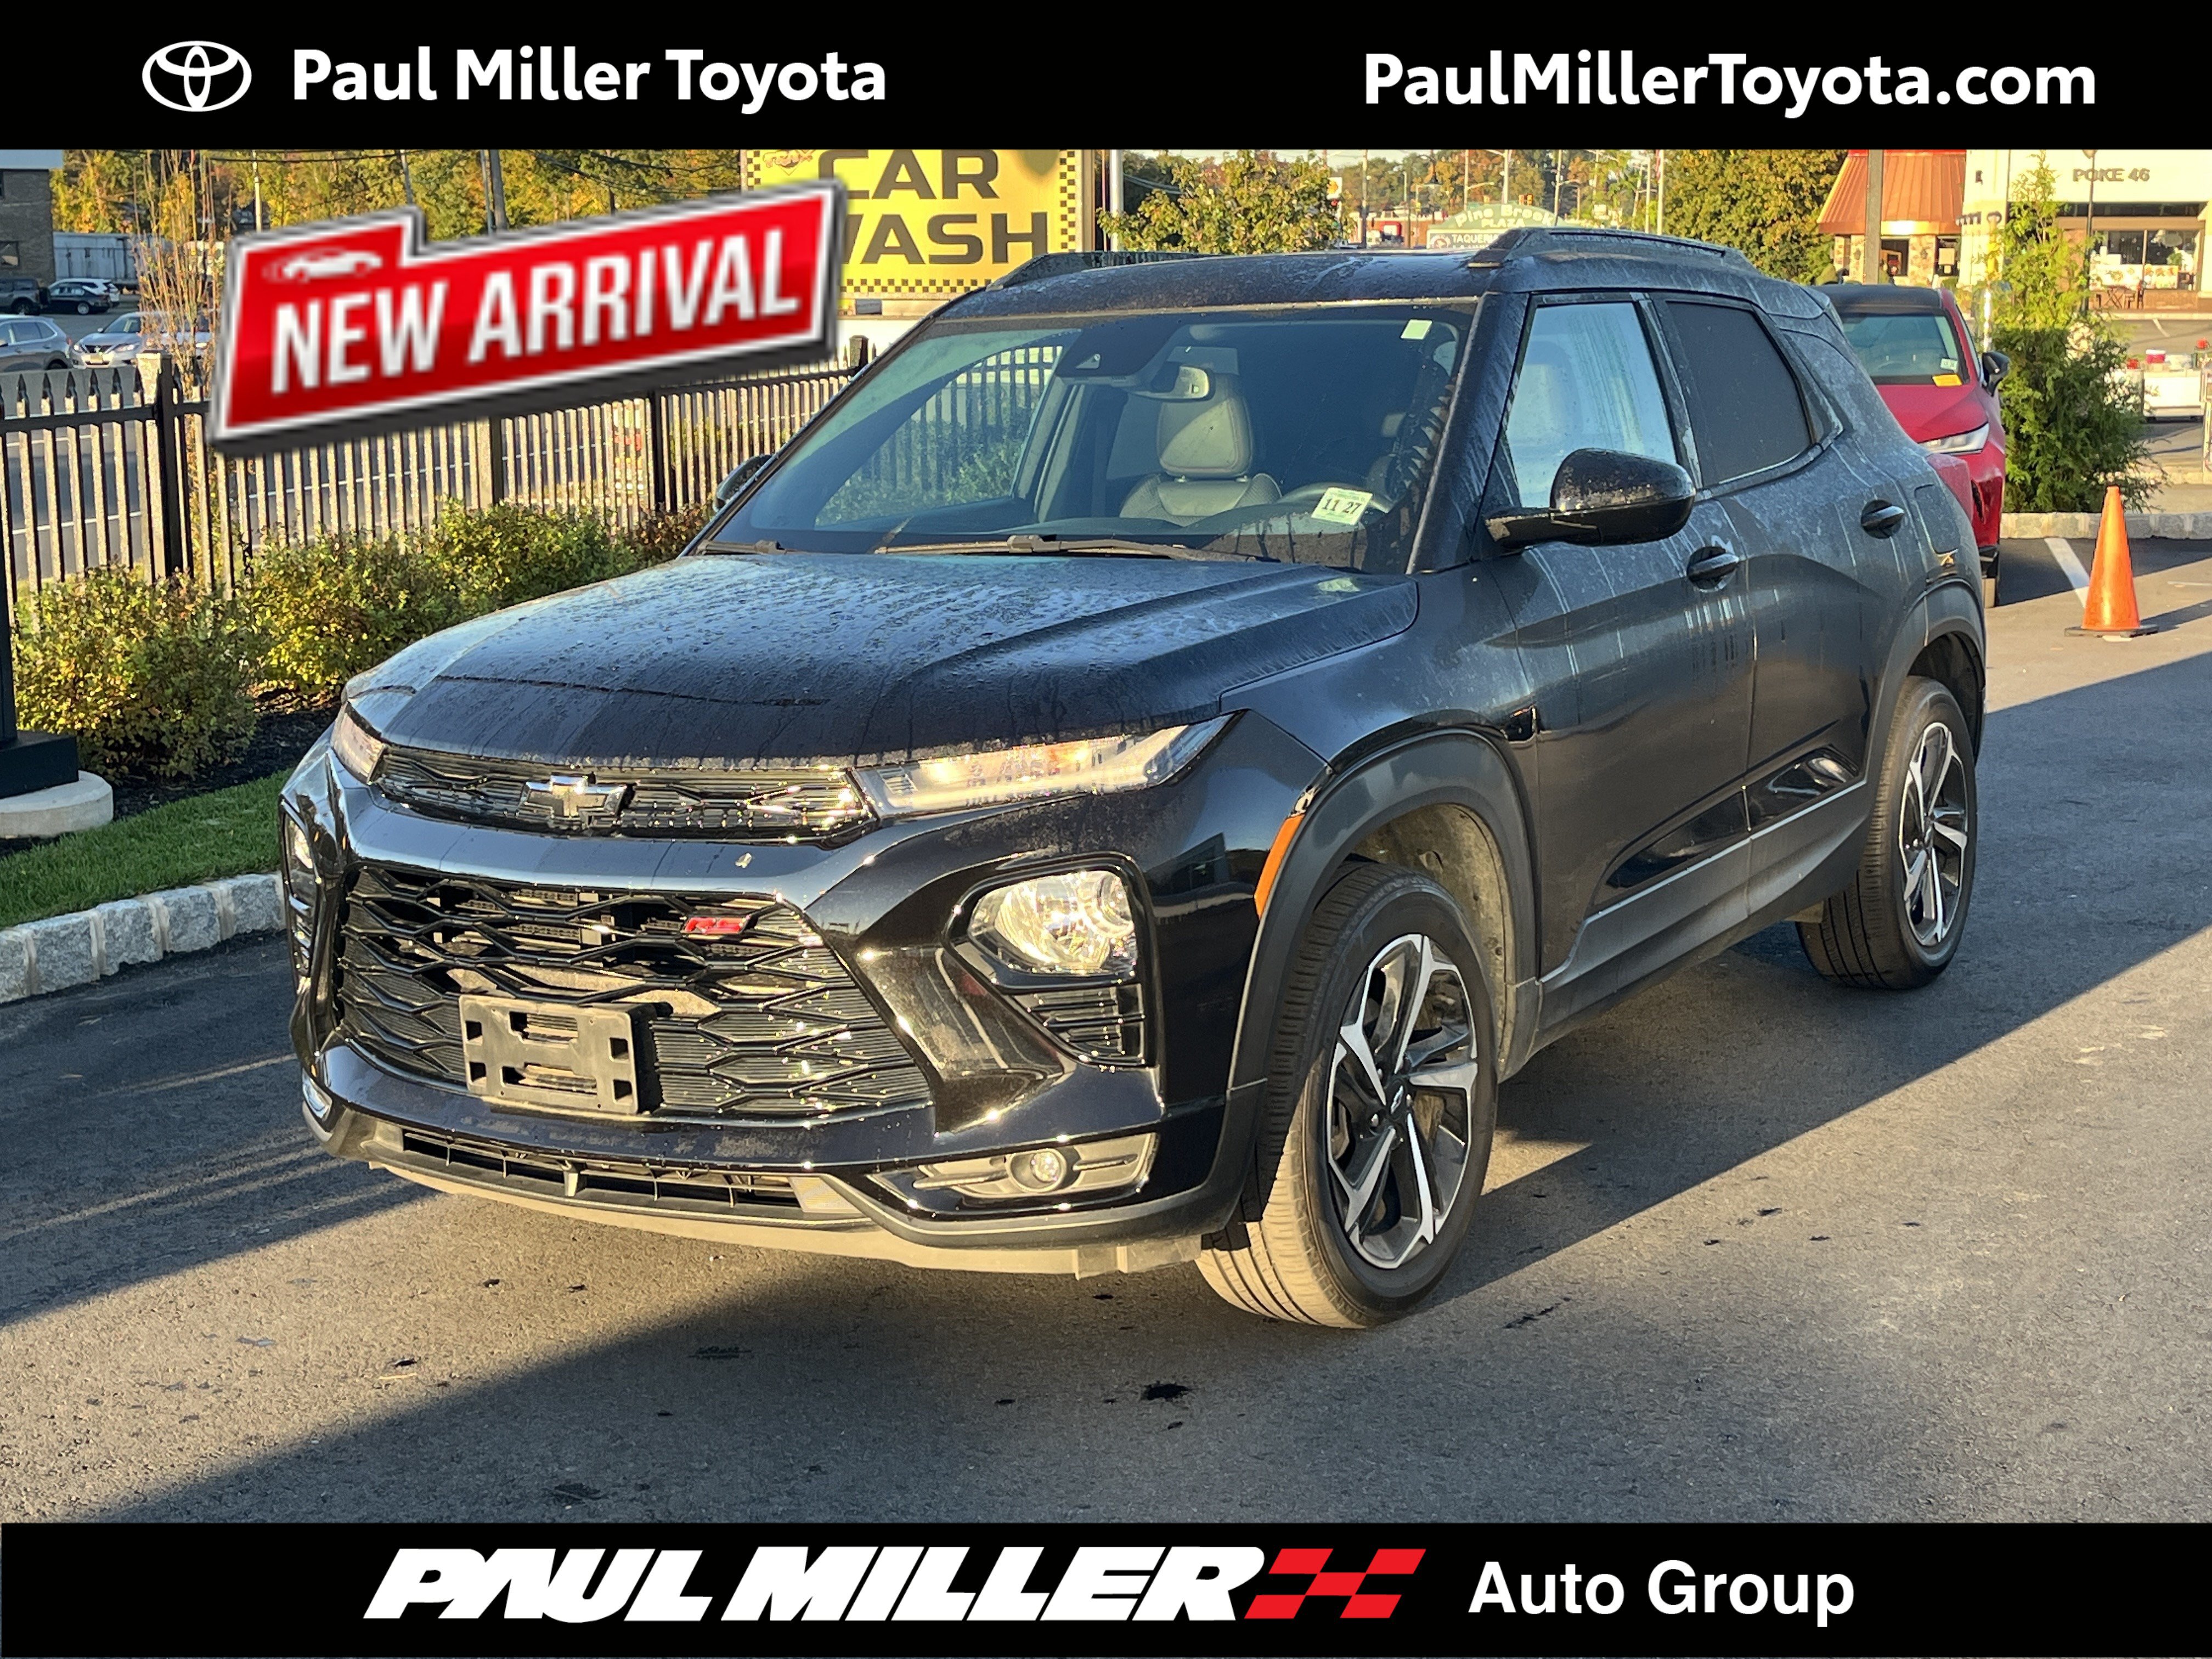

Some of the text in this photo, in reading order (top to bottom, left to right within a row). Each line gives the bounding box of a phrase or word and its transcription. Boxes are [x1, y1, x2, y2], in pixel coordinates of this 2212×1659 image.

[818, 149, 1000, 199] CAR
[2073, 167, 2151, 182] POKE 46
[1455, 204, 1555, 228] Pine Brook
[1481, 218, 1526, 228] PLAZA
[1321, 498, 1362, 515] 11 27
[685, 917, 744, 935] RS
